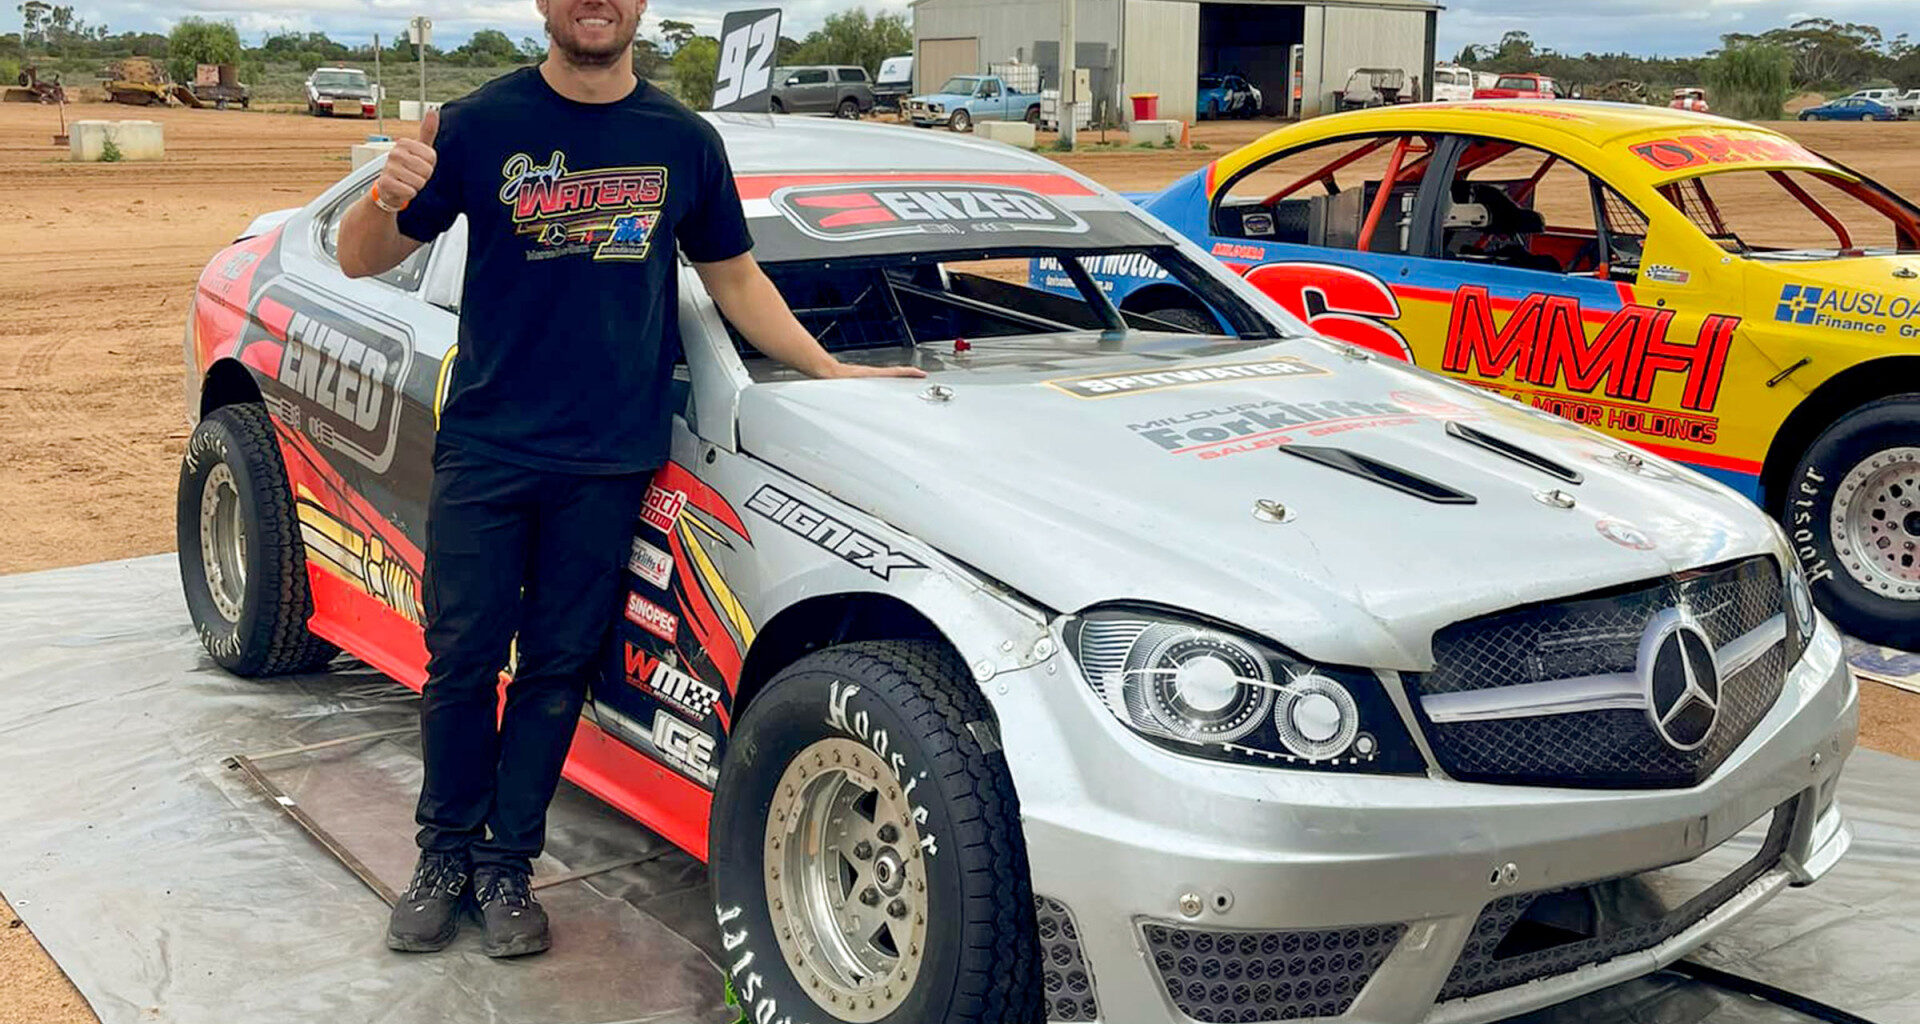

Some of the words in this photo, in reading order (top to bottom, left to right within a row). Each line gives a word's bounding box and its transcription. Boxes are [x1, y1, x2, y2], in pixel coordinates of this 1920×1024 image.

[712, 12, 781, 110] 92
[516, 175, 664, 218] WATERS
[873, 191, 1057, 221] ENZED
[1815, 313, 1887, 334] Finance
[1442, 284, 1742, 412] MMH
[279, 311, 388, 432] ENZED
[1077, 360, 1306, 394] SPITWATER
[1126, 401, 1283, 431] MILDURA
[1140, 400, 1412, 450] Forklifts
[1531, 395, 1604, 426] MOTOR
[1608, 409, 1718, 445] HOLDINGS
[1198, 435, 1293, 460] SALES
[1792, 466, 1834, 586] Hoosier
[627, 594, 676, 634] SINOPEC
[825, 680, 937, 856] Hoosier
